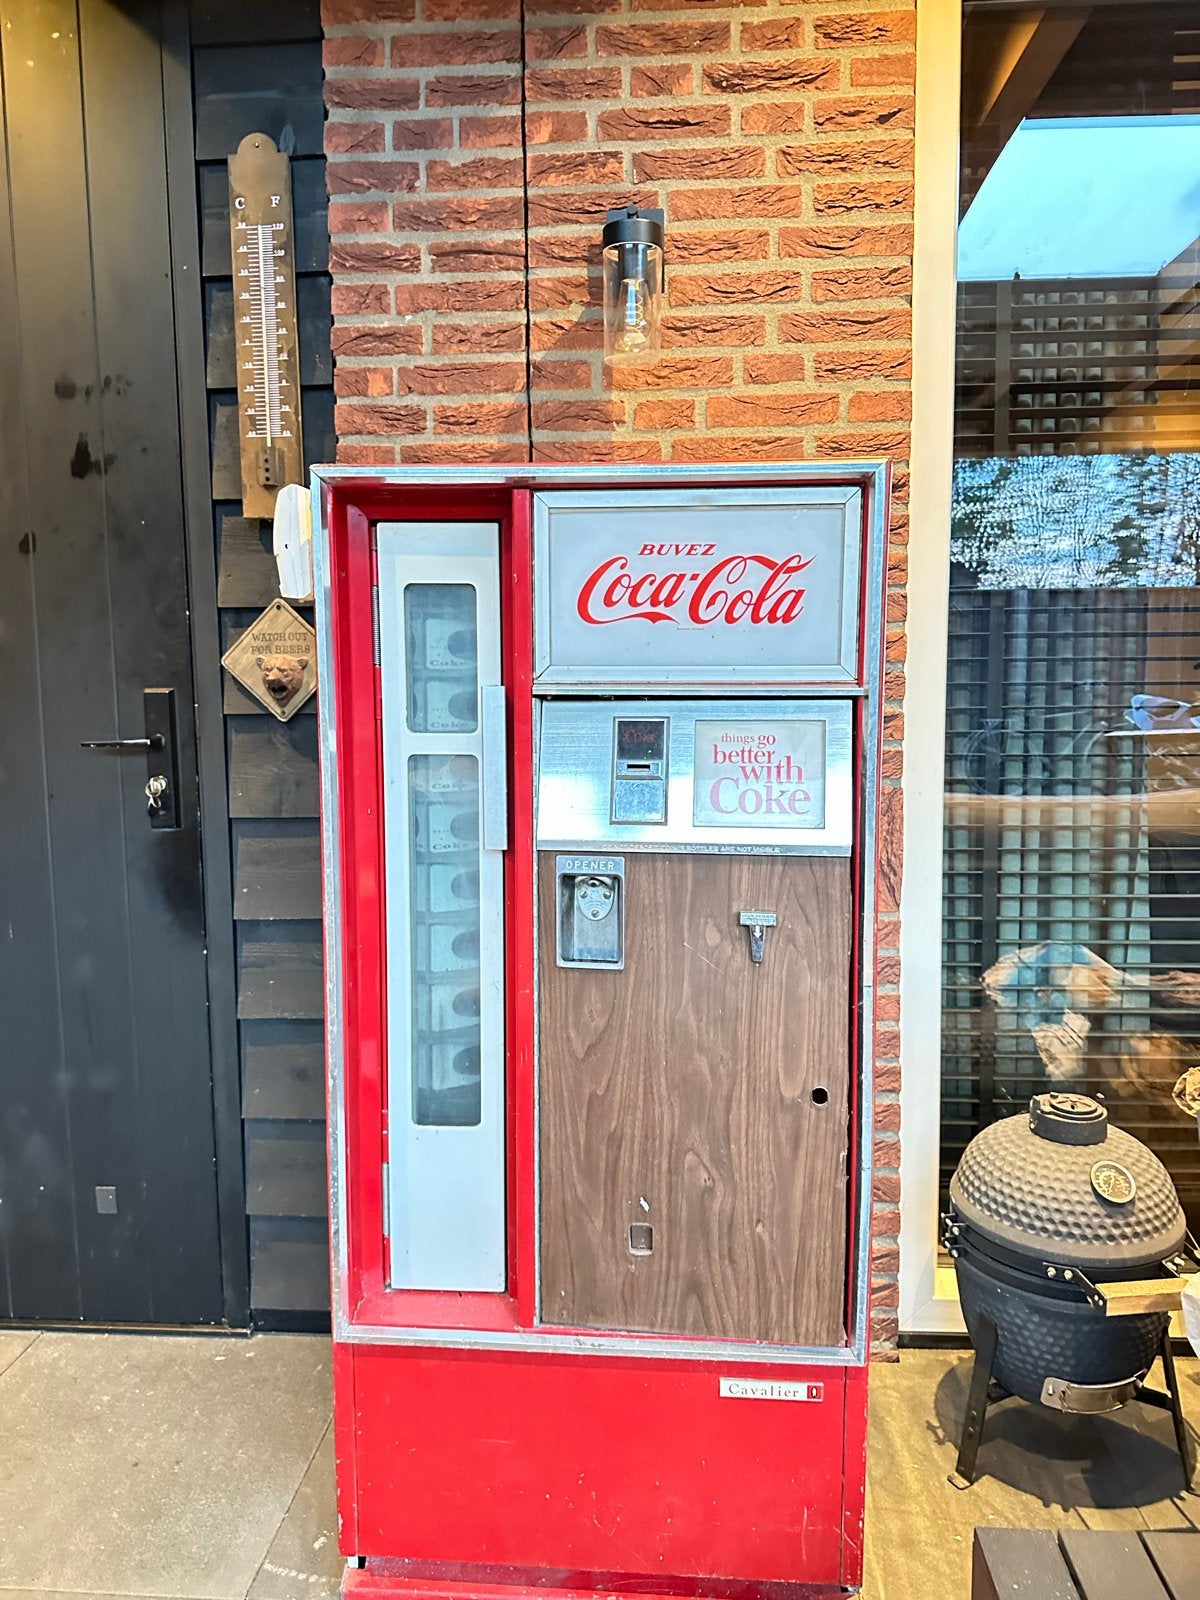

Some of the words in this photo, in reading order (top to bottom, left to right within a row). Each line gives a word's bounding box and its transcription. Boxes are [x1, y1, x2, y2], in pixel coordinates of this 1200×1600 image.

[235, 197, 245, 209] C
[270, 195, 280, 207] F
[638, 544, 717, 556] BUVEZ
[577, 554, 817, 625] Coca-Cola
[252, 632, 286, 642] WATCH
[288, 632, 308, 641] OUT
[251, 645, 272, 655] FOR
[275, 644, 311, 654] BEERS
[721, 733, 755, 744] things
[757, 734, 776, 749] go
[713, 744, 776, 764] better
[739, 755, 805, 785] with
[709, 777, 811, 815] Coke
[566, 860, 615, 870] OPENER
[728, 1383, 799, 1398] Cavalier
